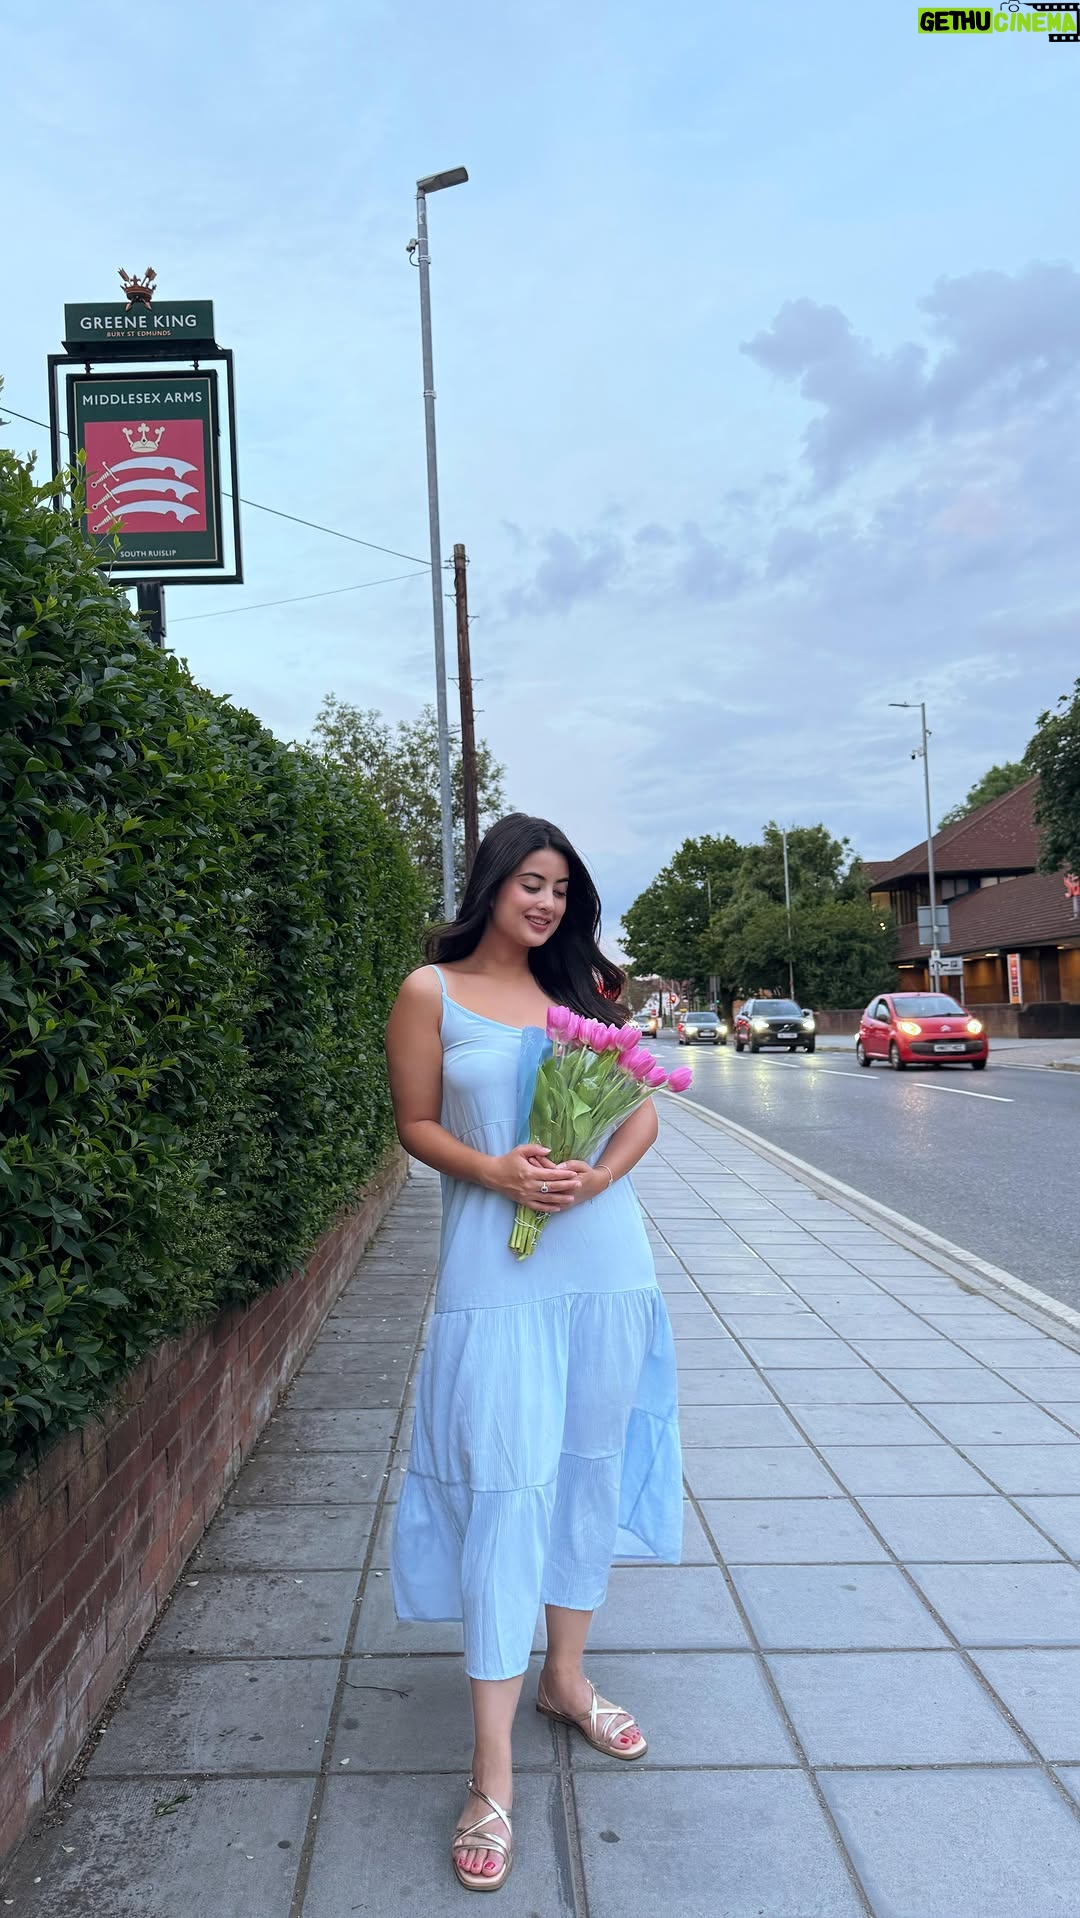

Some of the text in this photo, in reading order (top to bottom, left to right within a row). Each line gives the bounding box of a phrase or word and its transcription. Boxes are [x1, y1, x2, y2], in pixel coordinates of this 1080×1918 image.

[80, 314, 197, 330] GREENE KING
[137, 329, 171, 337] EDMUNDS
[82, 391, 202, 406] MIDDLESEX ARMS
[120, 549, 177, 558] SOUTH RUISLIP
